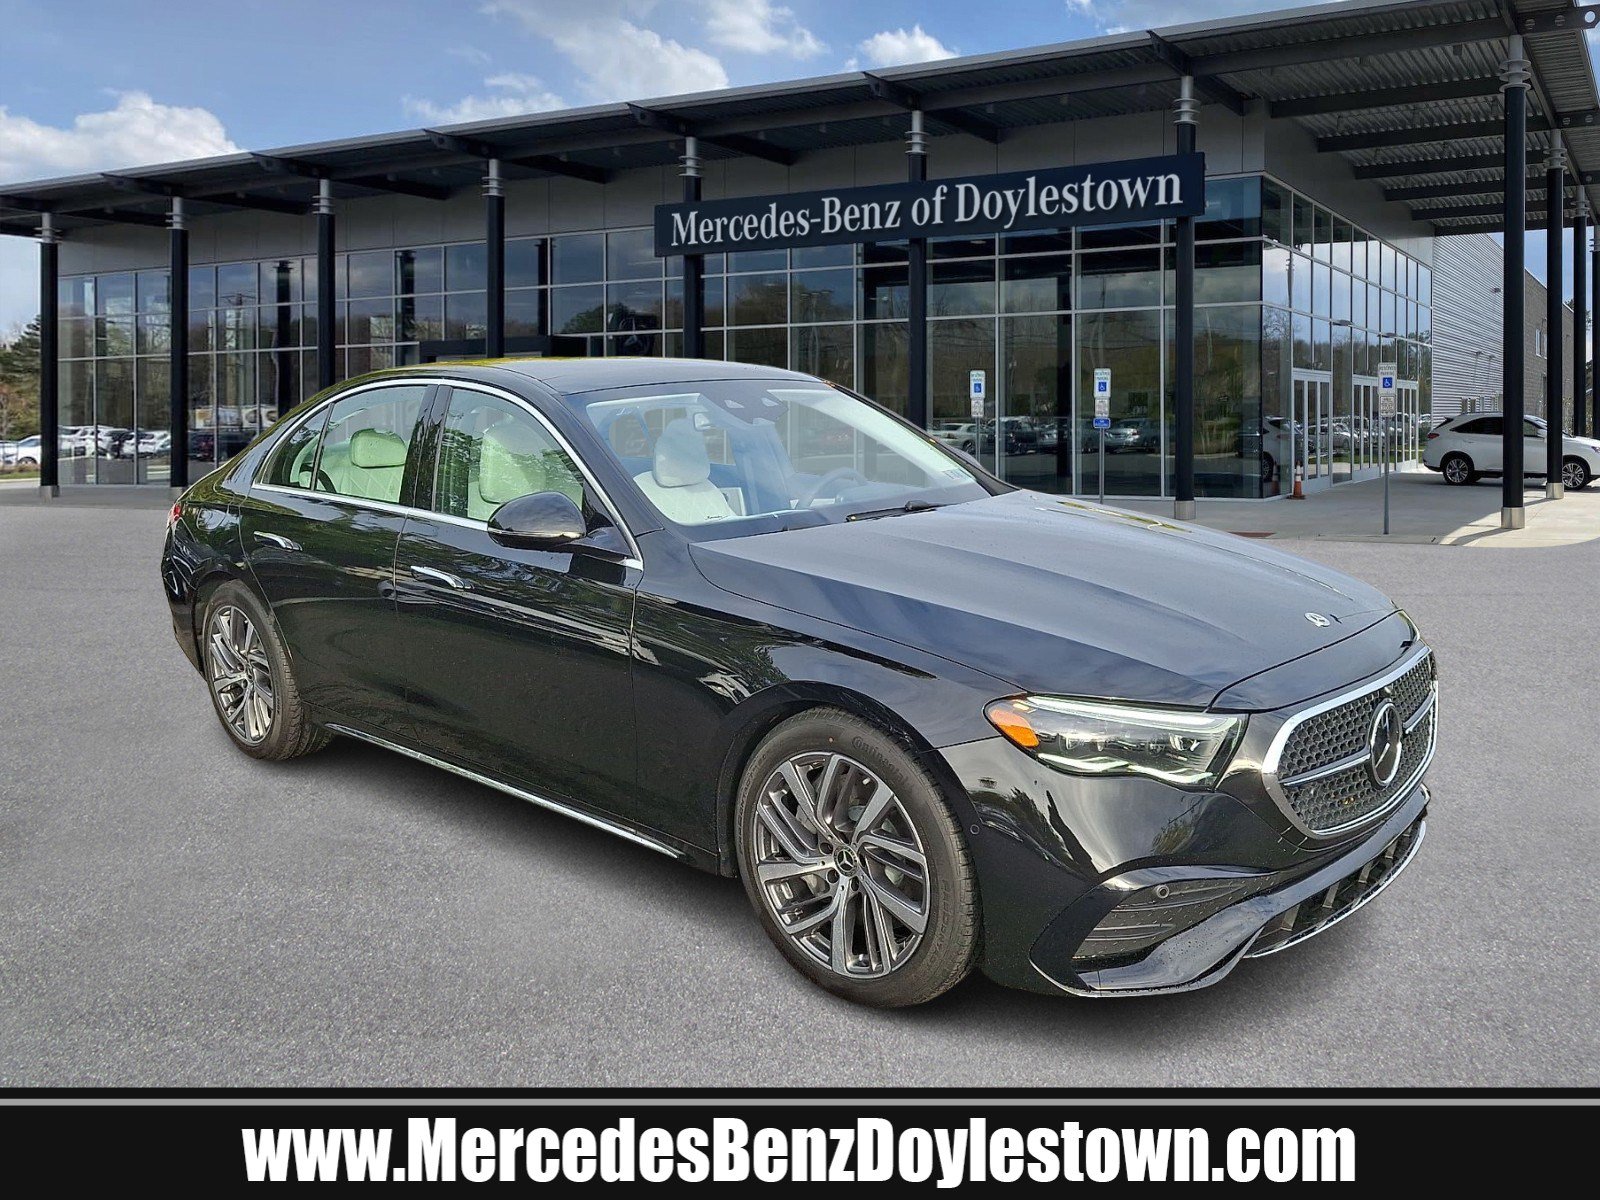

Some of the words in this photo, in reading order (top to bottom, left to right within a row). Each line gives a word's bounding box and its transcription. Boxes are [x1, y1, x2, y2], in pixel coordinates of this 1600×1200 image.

[670, 197, 902, 246] Mercedes-Benz
[911, 184, 948, 226] of
[954, 172, 1183, 229] Doylestown
